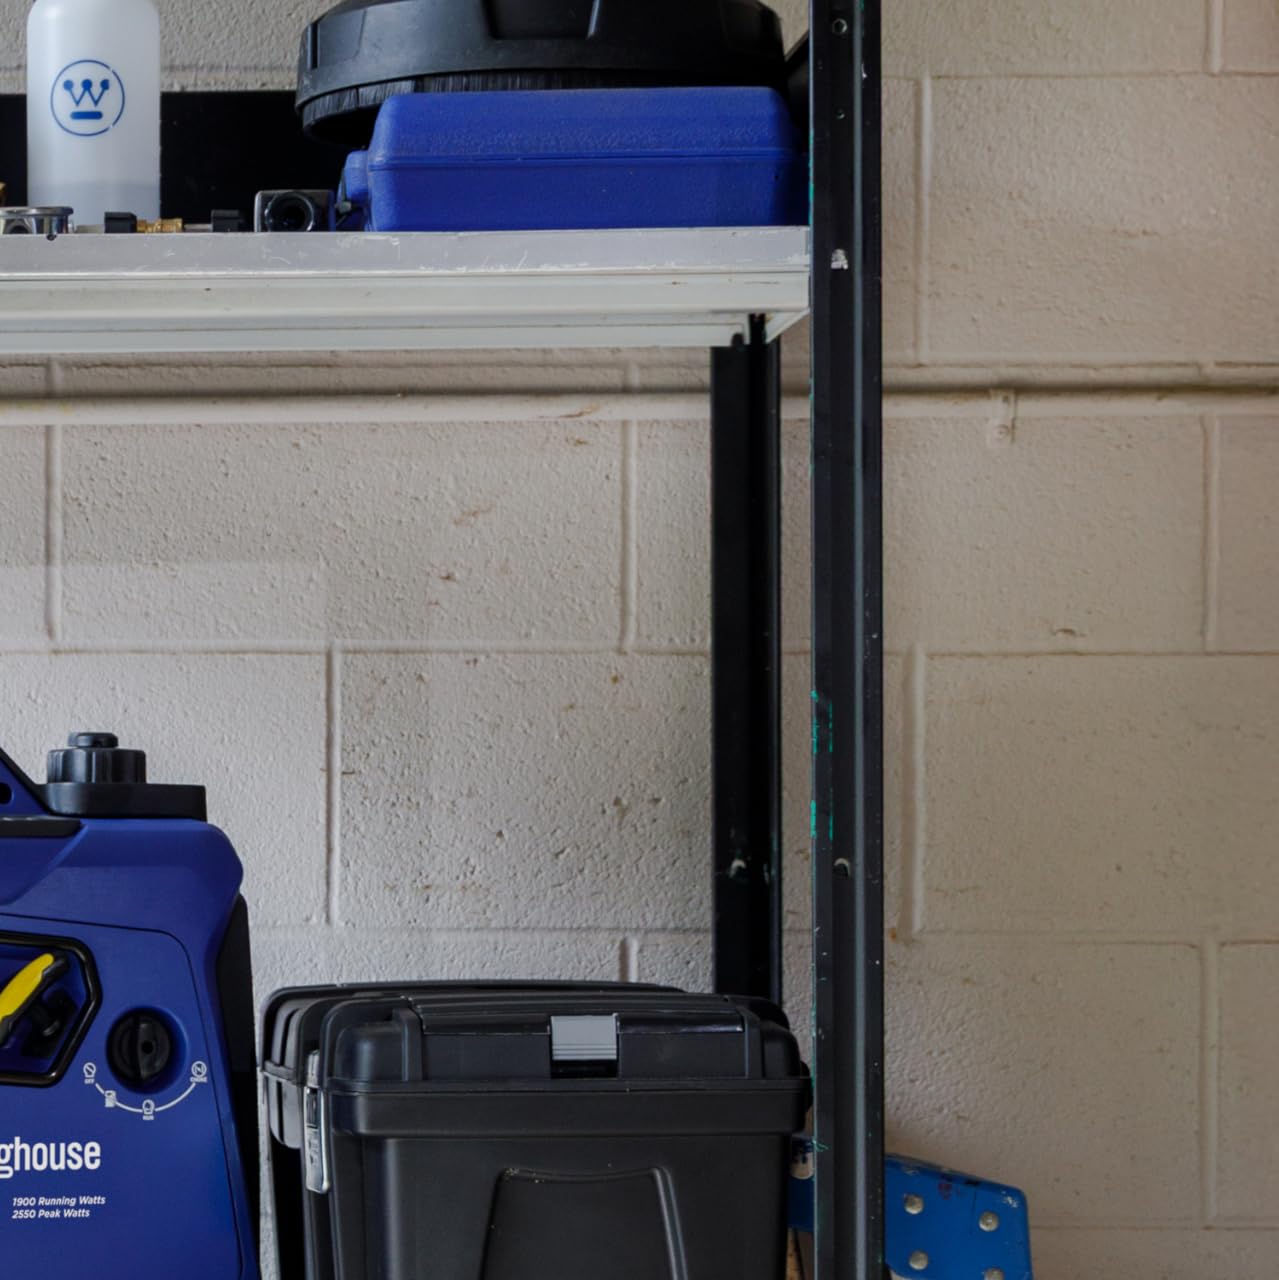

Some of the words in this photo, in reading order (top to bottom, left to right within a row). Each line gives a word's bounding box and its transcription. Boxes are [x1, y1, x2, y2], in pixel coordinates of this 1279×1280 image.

[12, 1197, 37, 1207] 1900
[38, 1196, 77, 1207] Running
[79, 1195, 107, 1205] Watts
[12, 1209, 37, 1219] 2550
[38, 1208, 61, 1218] Peak
[63, 1208, 91, 1218] Watts
